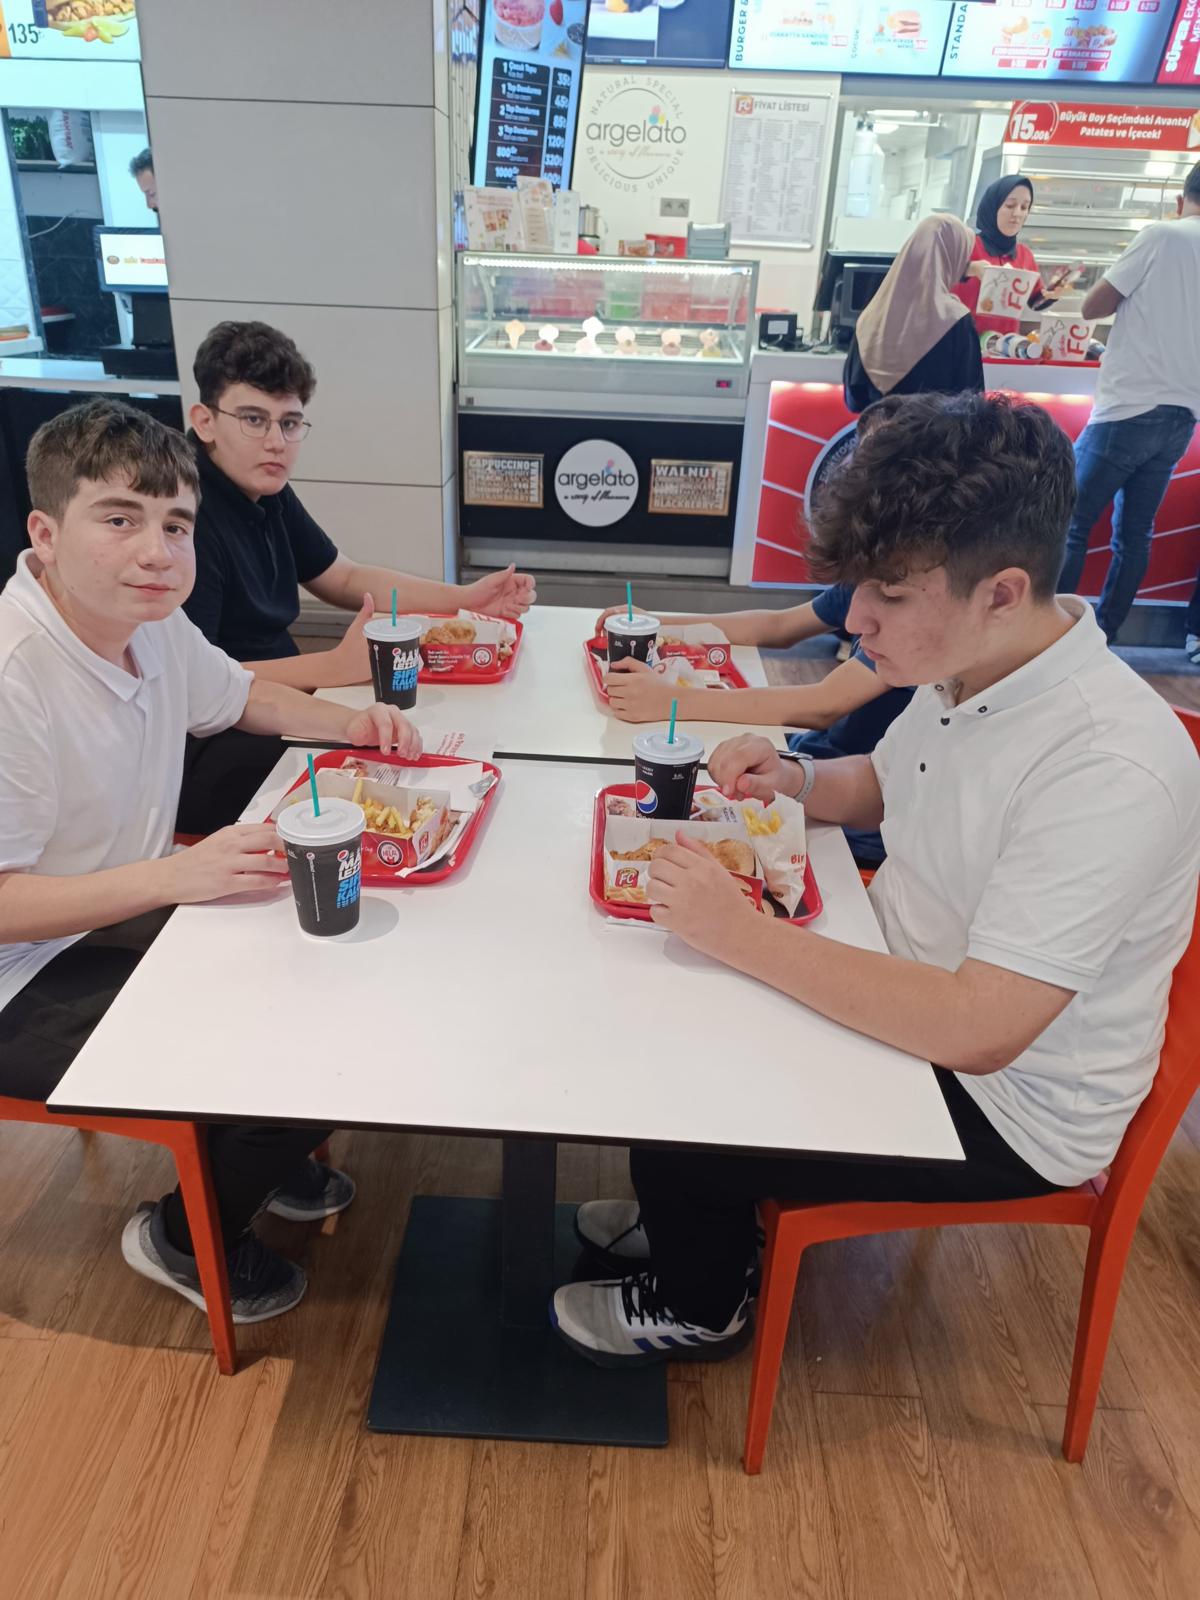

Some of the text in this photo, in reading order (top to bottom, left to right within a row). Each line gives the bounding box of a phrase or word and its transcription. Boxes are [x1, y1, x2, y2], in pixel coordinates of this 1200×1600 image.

[735, 12, 748, 61] BURGER
[590, 74, 684, 119] NATURAL SPECIAL
[1060, 111, 1192, 129] Büyük Boy Seçimdeki Avantaj
[1080, 126, 1115, 137] Patates
[1115, 130, 1127, 138] ve
[586, 119, 687, 148] argelato
[586, 146, 684, 193] DELICIOUS UNIQUE
[1008, 277, 1029, 310] FC
[1067, 324, 1089, 355] FC
[468, 458, 530, 470] CAPPUCCINO
[656, 466, 716, 478] WALNUT
[558, 469, 635, 490] argelato
[619, 873, 635, 885] FC
